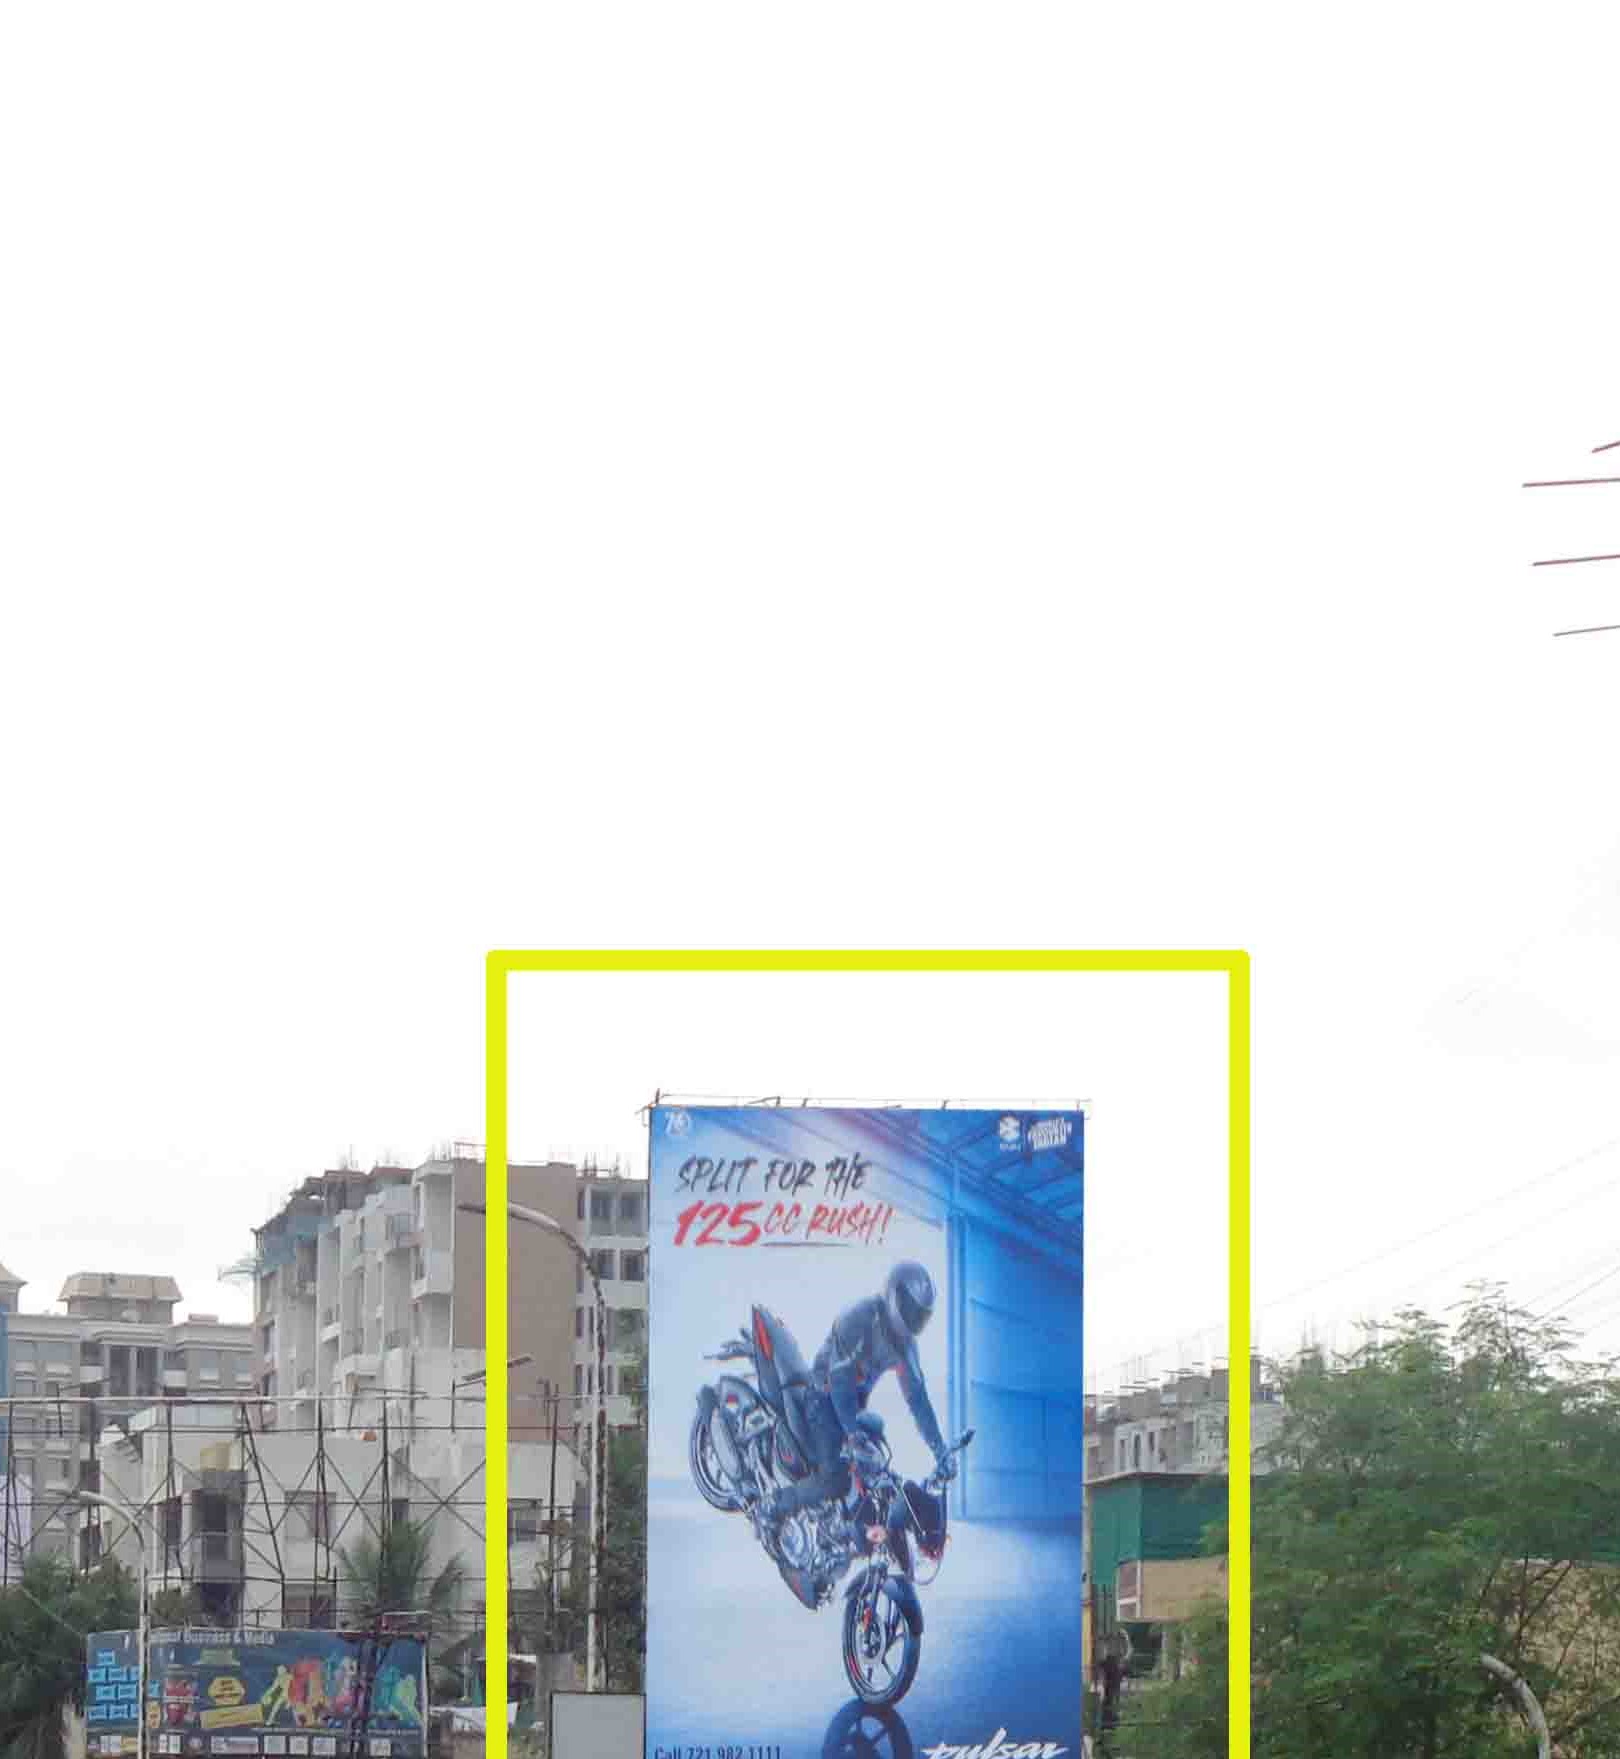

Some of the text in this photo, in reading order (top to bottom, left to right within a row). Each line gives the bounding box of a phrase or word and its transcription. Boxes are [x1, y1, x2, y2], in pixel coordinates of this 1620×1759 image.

[675, 1152, 873, 1200] SPLIT FOR THE
